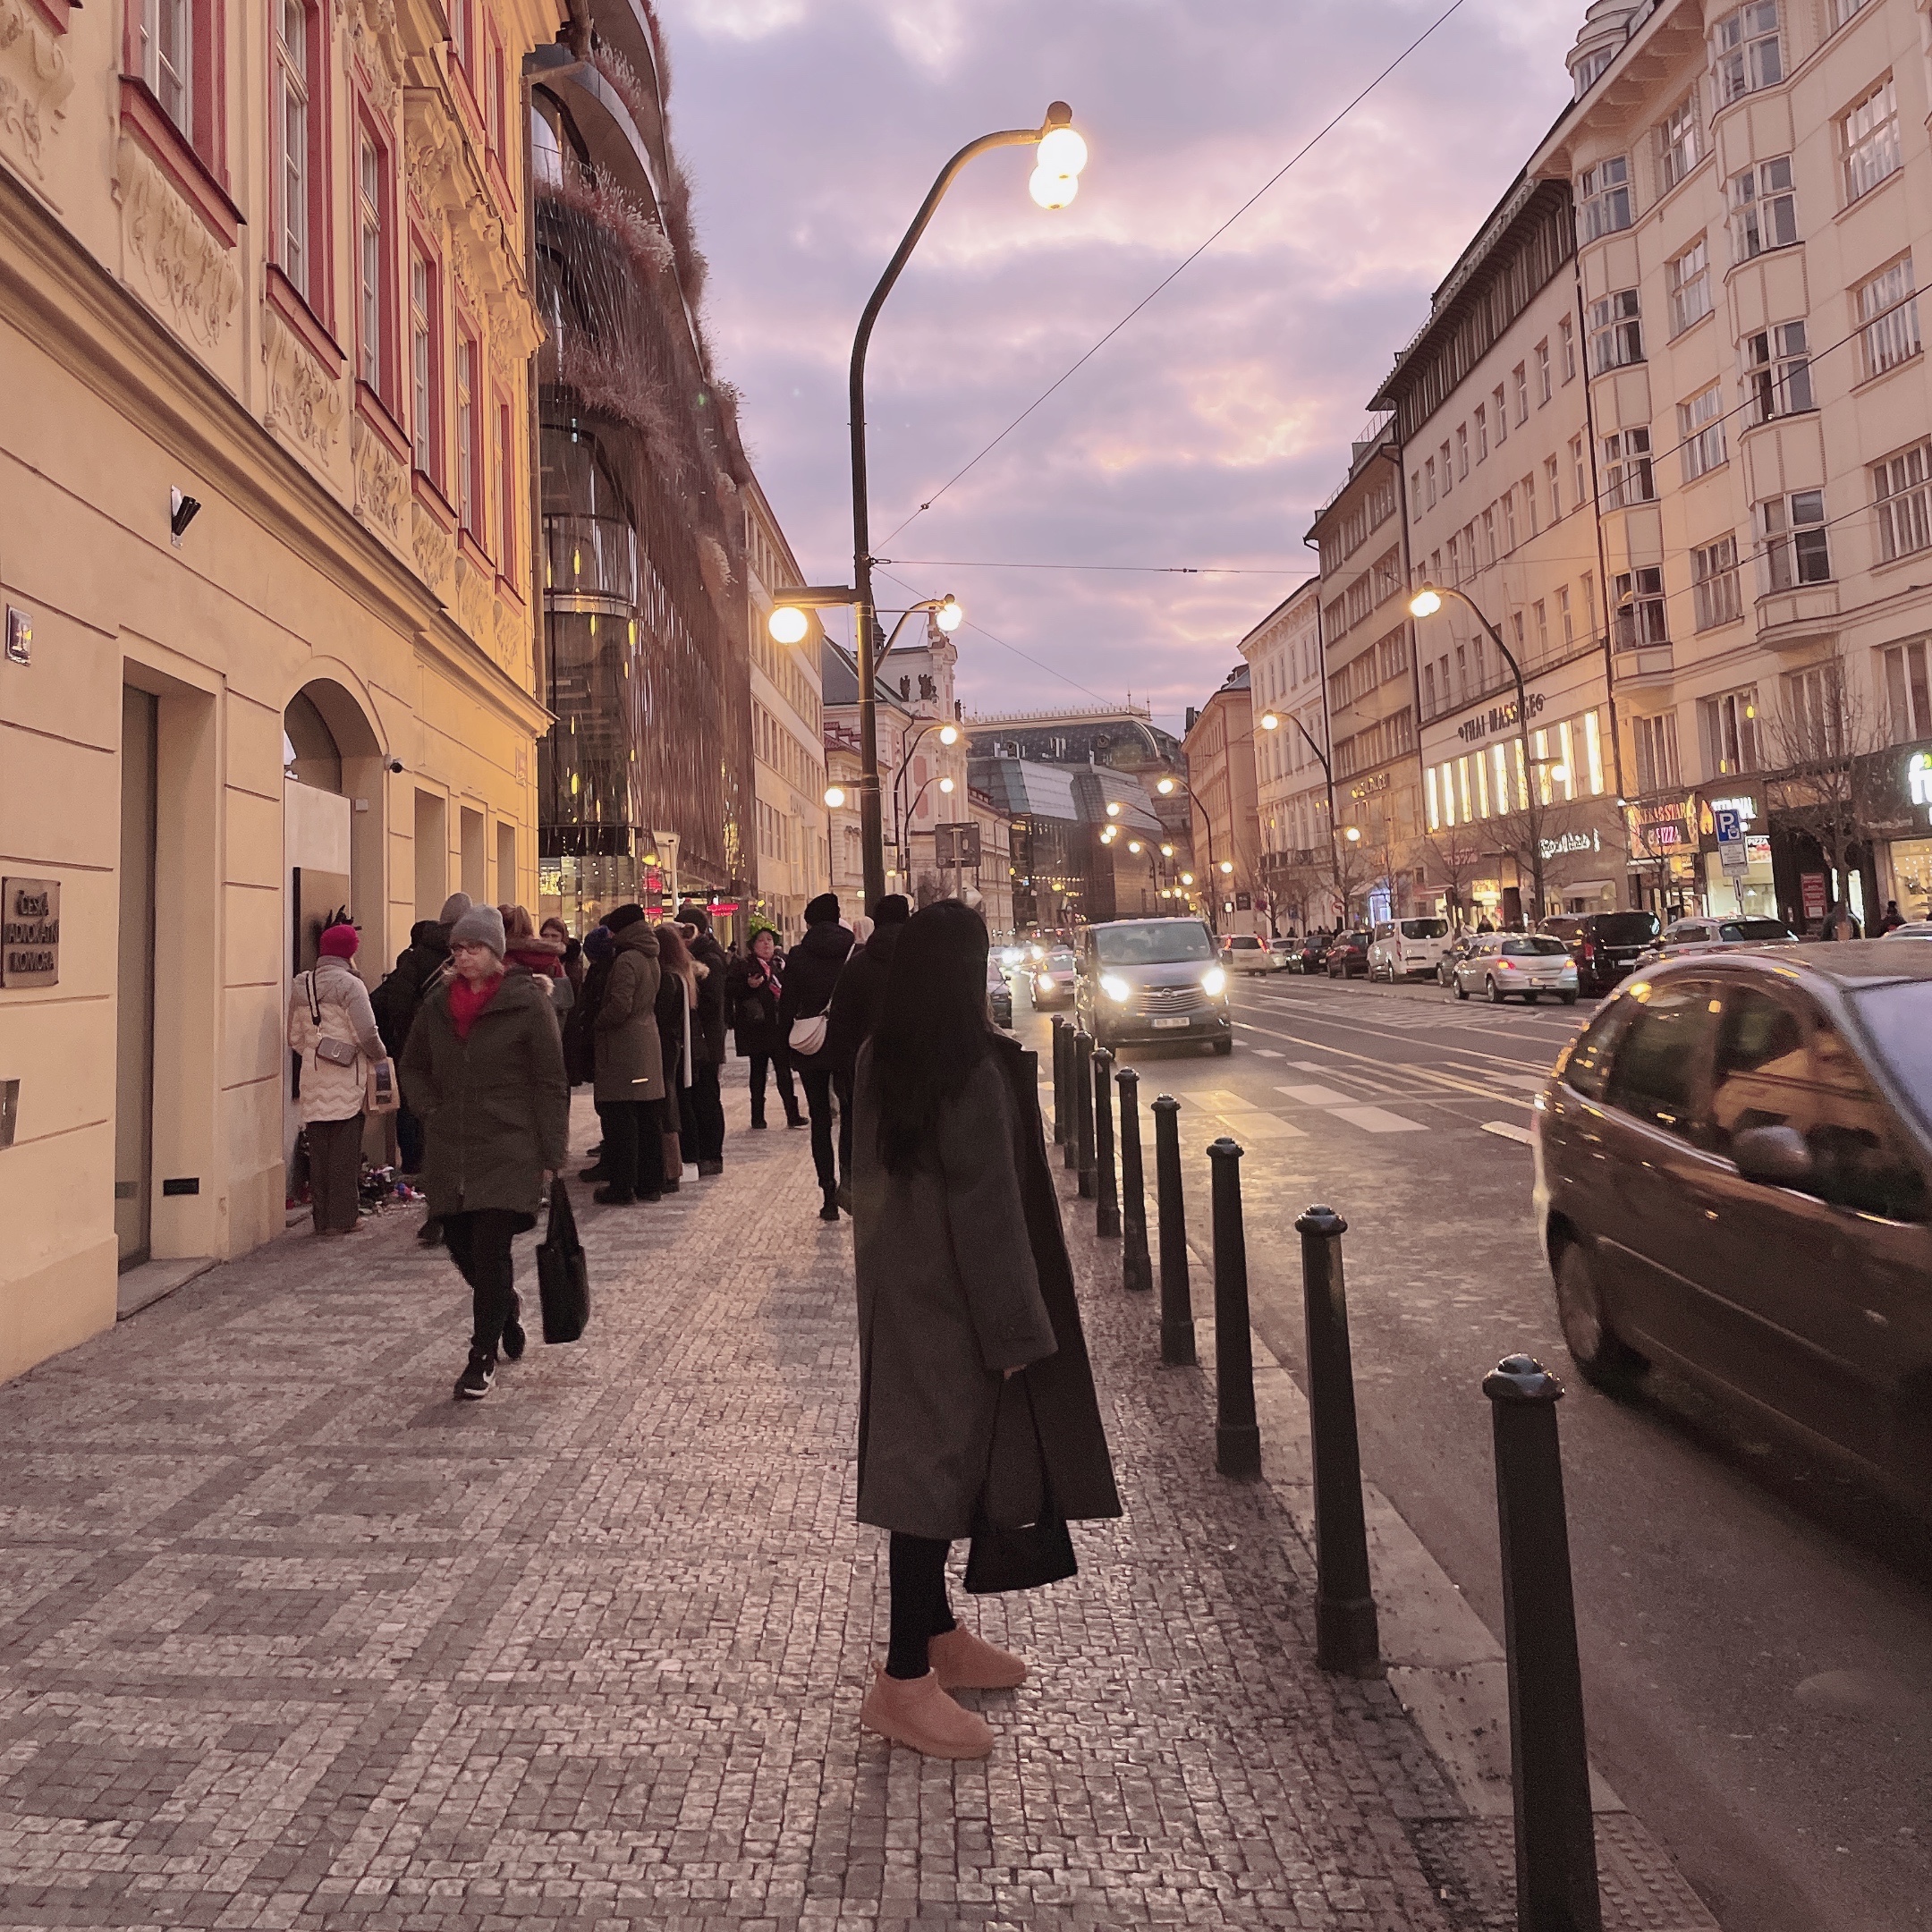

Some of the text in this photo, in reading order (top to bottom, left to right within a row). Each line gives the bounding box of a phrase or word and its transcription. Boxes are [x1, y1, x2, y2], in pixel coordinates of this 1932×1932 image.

[1463, 694, 1536, 742] THAI MASSGE
[1718, 812, 1735, 833] P
